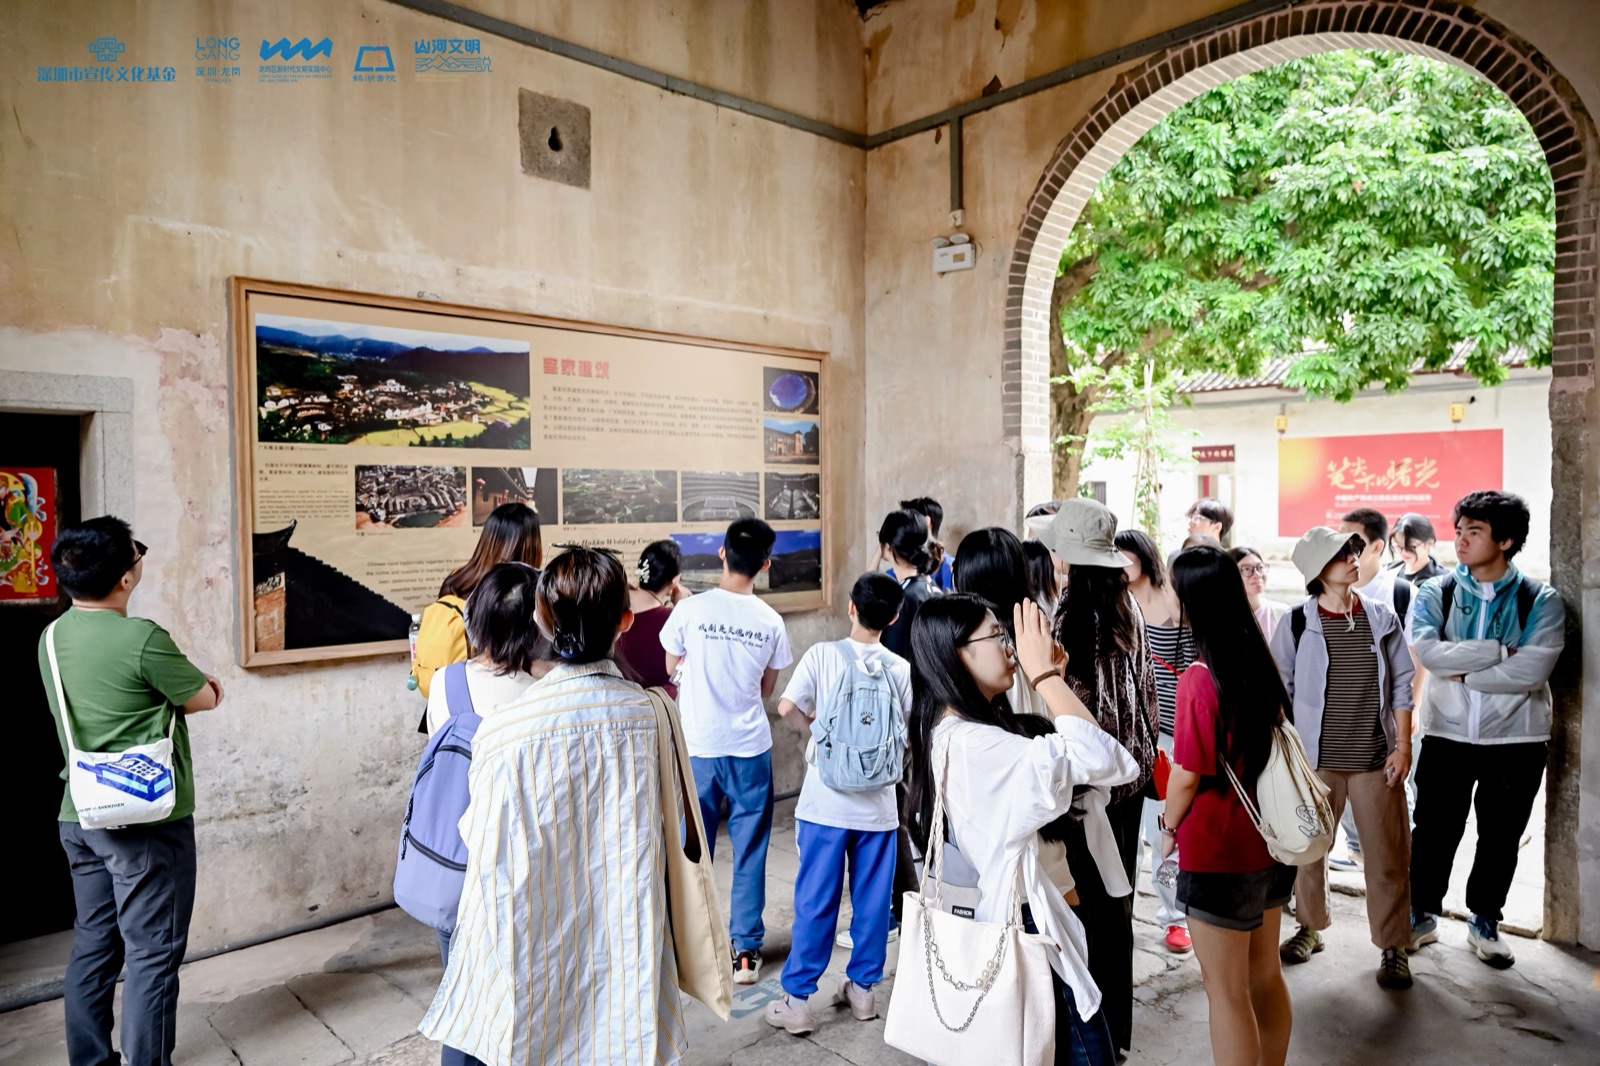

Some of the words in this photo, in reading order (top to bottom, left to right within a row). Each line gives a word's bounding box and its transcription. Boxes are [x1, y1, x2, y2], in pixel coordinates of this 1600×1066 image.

[1326, 456, 1440, 492] 笔尖下的曙光
[953, 908, 973, 916] FASHION
